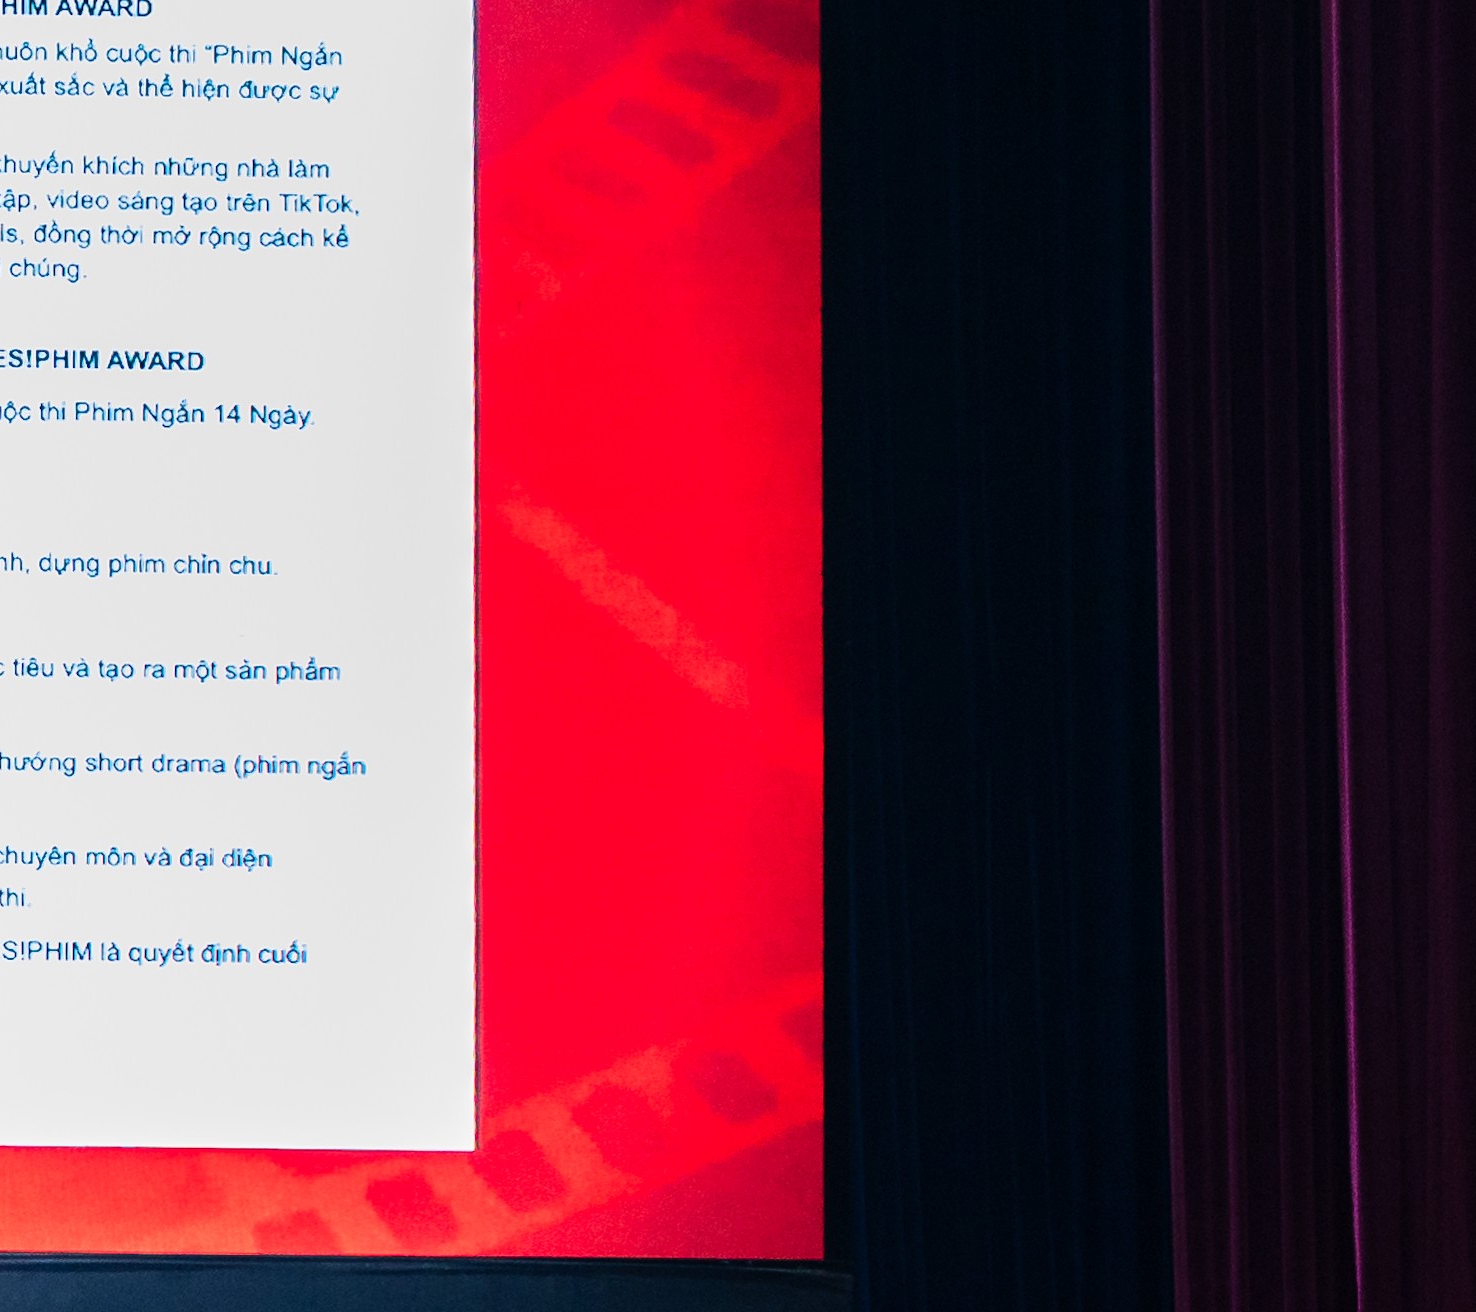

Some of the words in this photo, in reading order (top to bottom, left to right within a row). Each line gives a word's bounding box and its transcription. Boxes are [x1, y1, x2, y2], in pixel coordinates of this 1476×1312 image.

[56, 38, 98, 62] khổ
[106, 43, 161, 66] cuộc
[169, 45, 196, 63] thi
[205, 44, 272, 65] “Phim
[282, 42, 342, 71] Ngắn
[9, 258, 88, 283] chúng.
[107, 351, 205, 371] AWARD
[86, 847, 137, 866] môn
[144, 847, 172, 867] và
[179, 848, 214, 871] đại
[222, 848, 273, 872] diện
